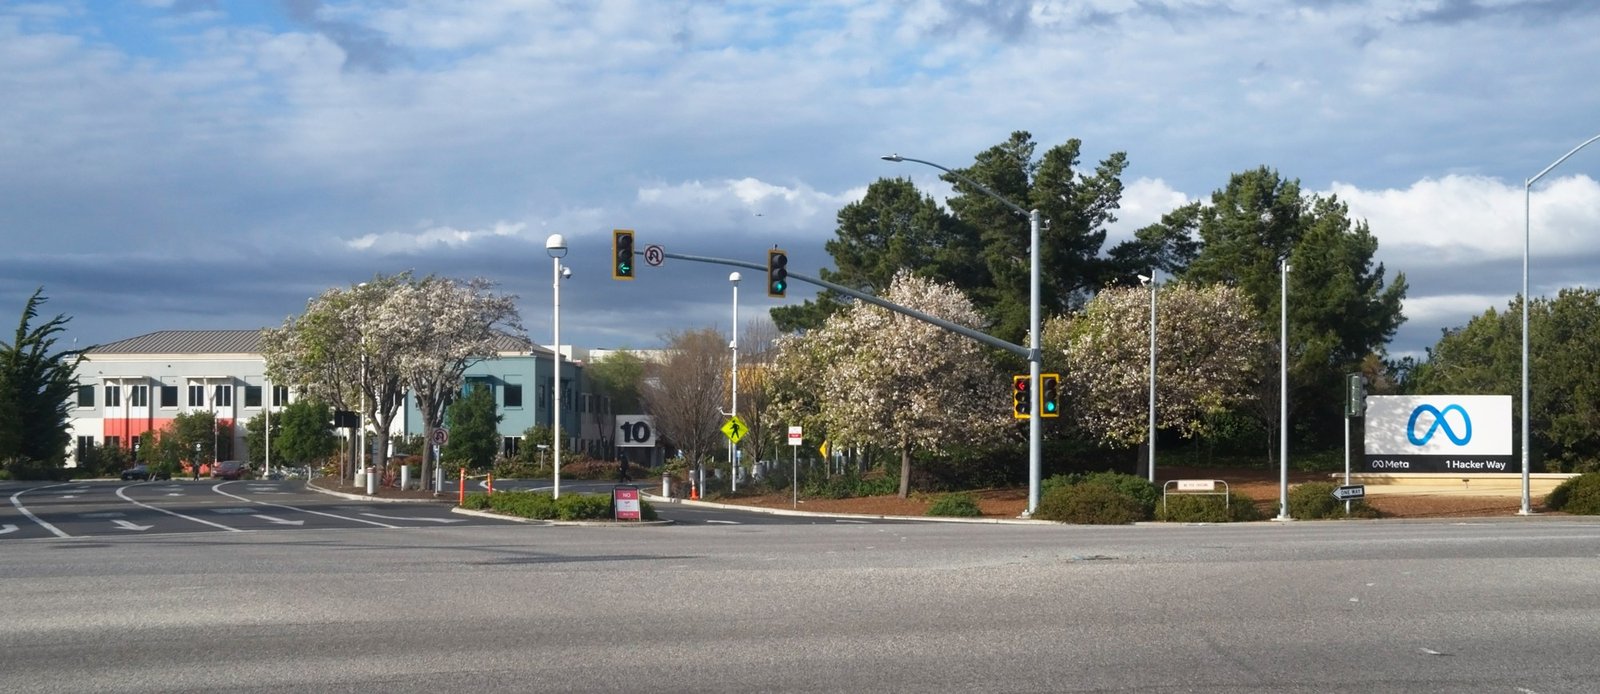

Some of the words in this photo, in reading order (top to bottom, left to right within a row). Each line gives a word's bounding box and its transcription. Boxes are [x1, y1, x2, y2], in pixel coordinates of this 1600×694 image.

[620, 421, 651, 443] 10
[1385, 460, 1410, 469] Meta
[1445, 460, 1450, 469] 1
[1452, 460, 1484, 469] Hacker
[1485, 460, 1506, 471] Way
